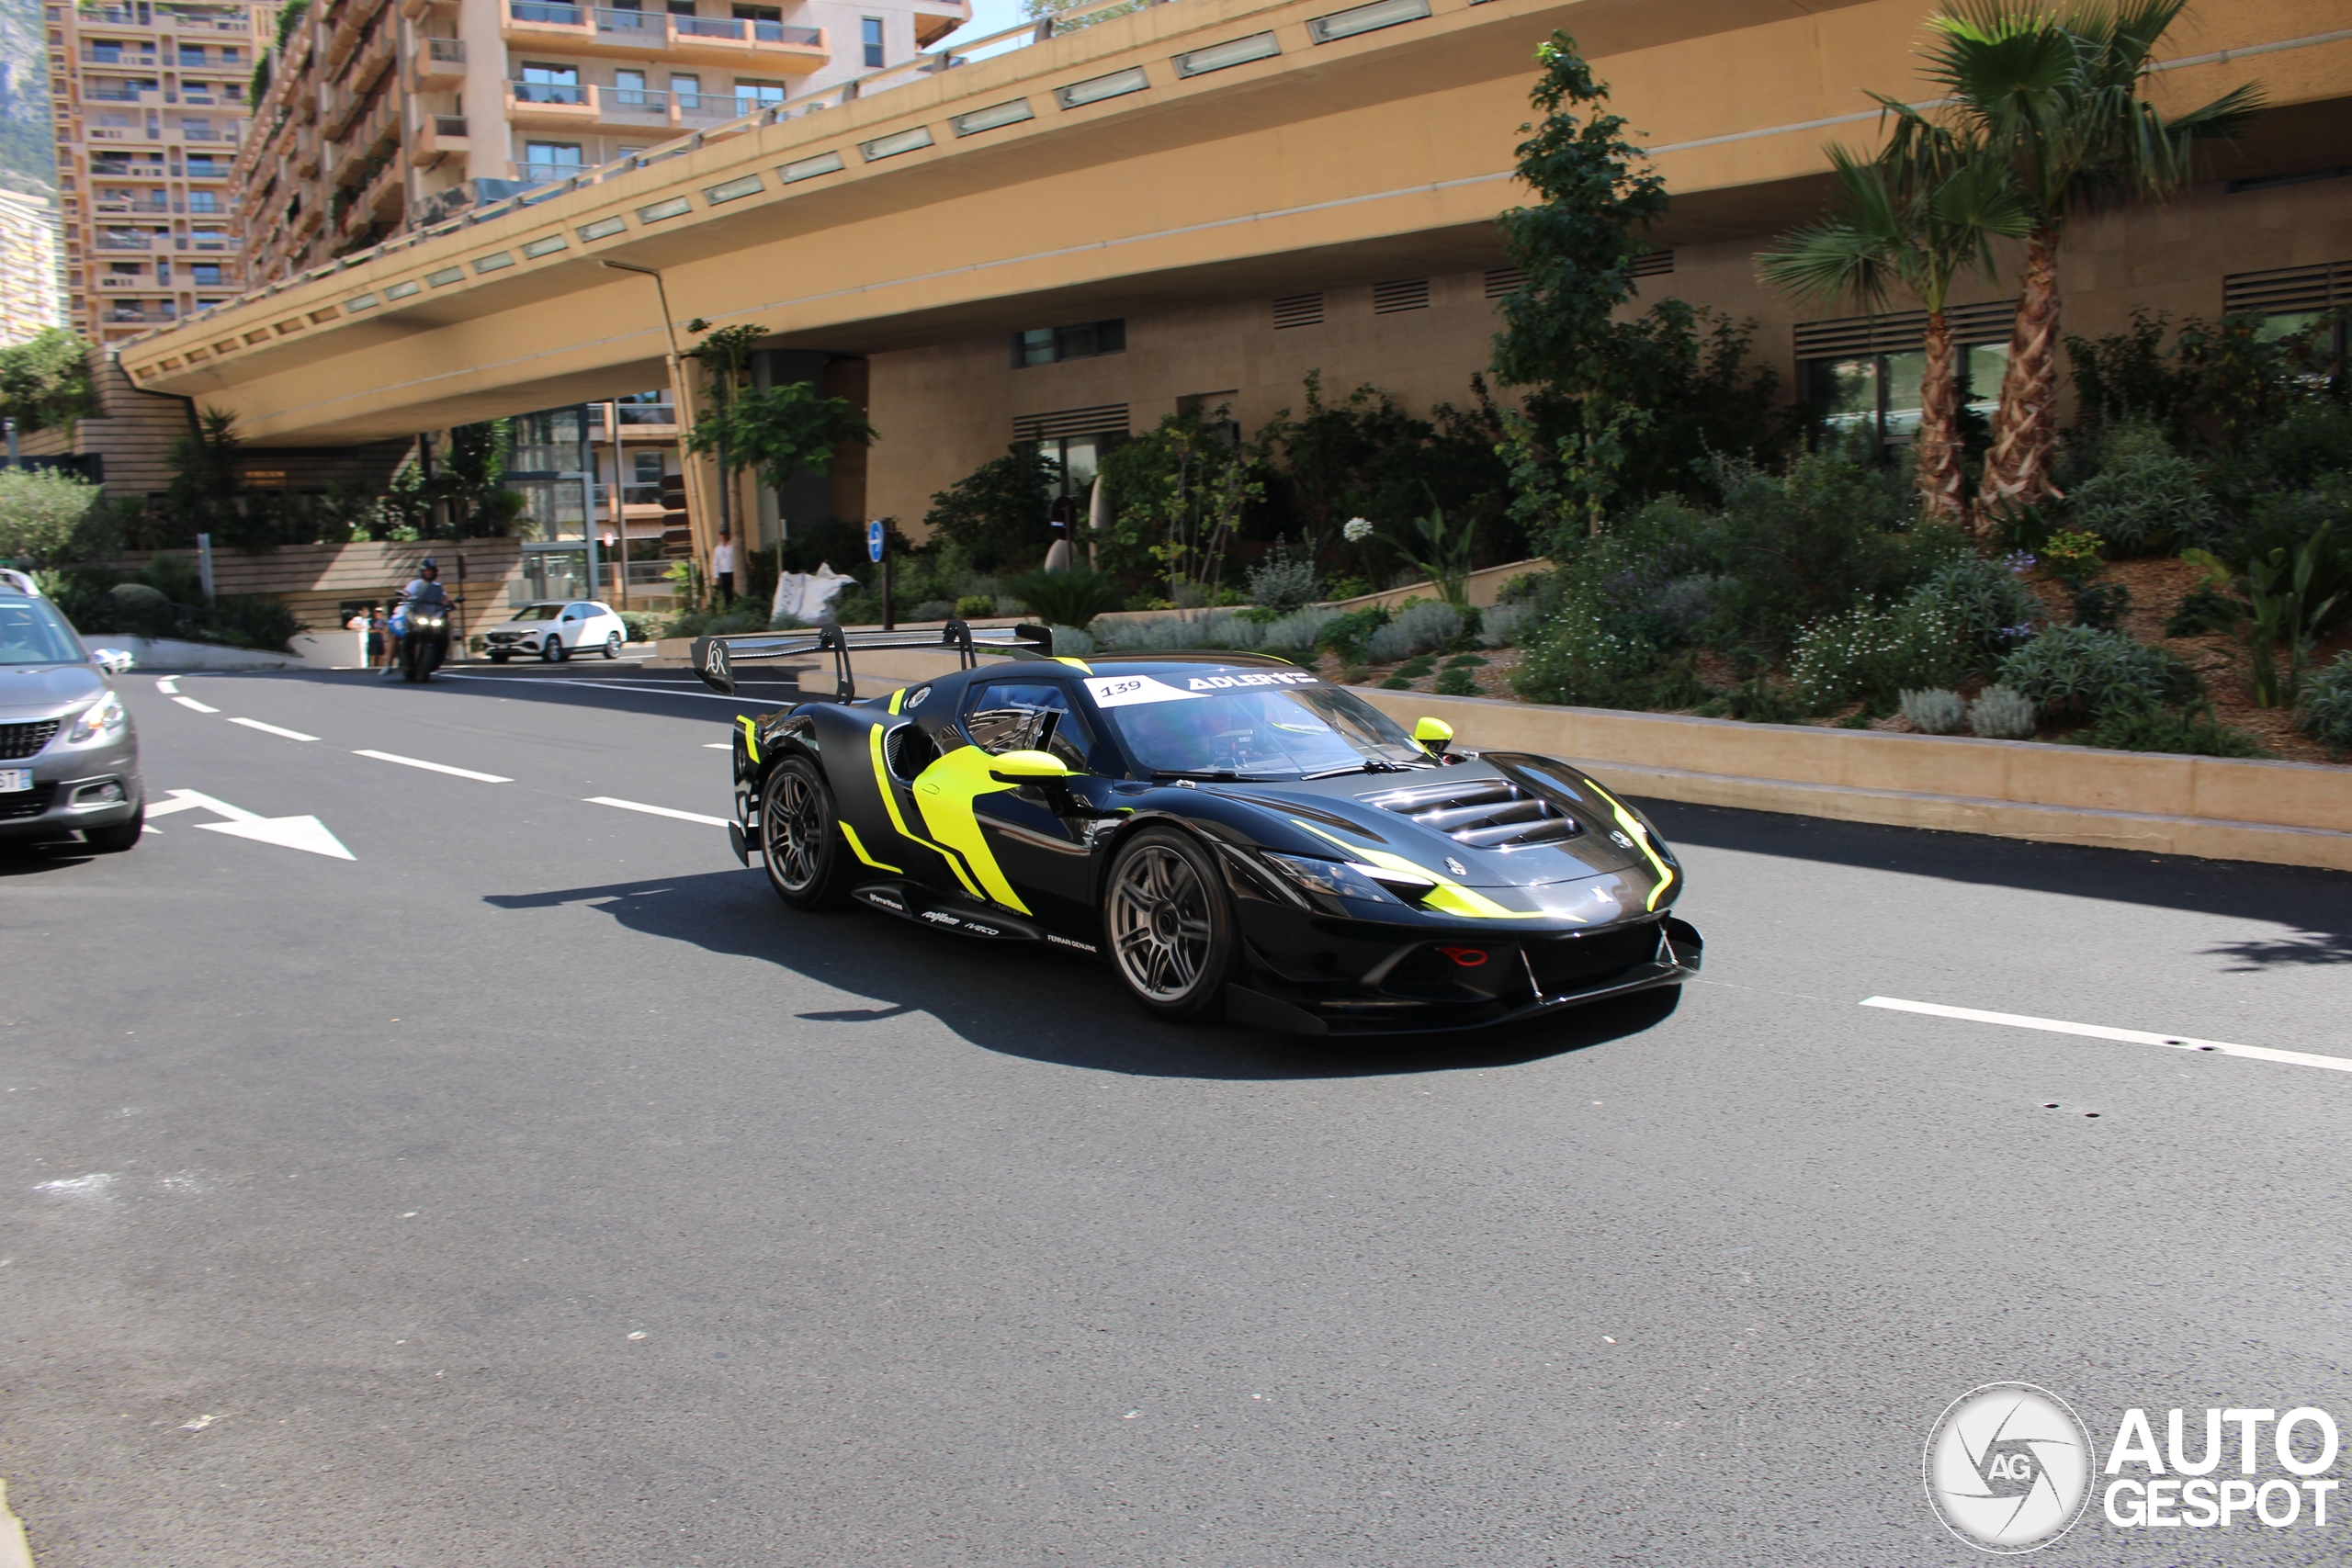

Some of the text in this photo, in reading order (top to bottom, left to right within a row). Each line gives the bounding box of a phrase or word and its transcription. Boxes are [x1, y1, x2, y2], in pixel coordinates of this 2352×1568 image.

[1100, 681, 1141, 698] 139
[1187, 673, 1281, 691] ADLER
[964, 922, 1000, 936] IVECO
[1047, 934, 1097, 953] FERRARI GENUINE
